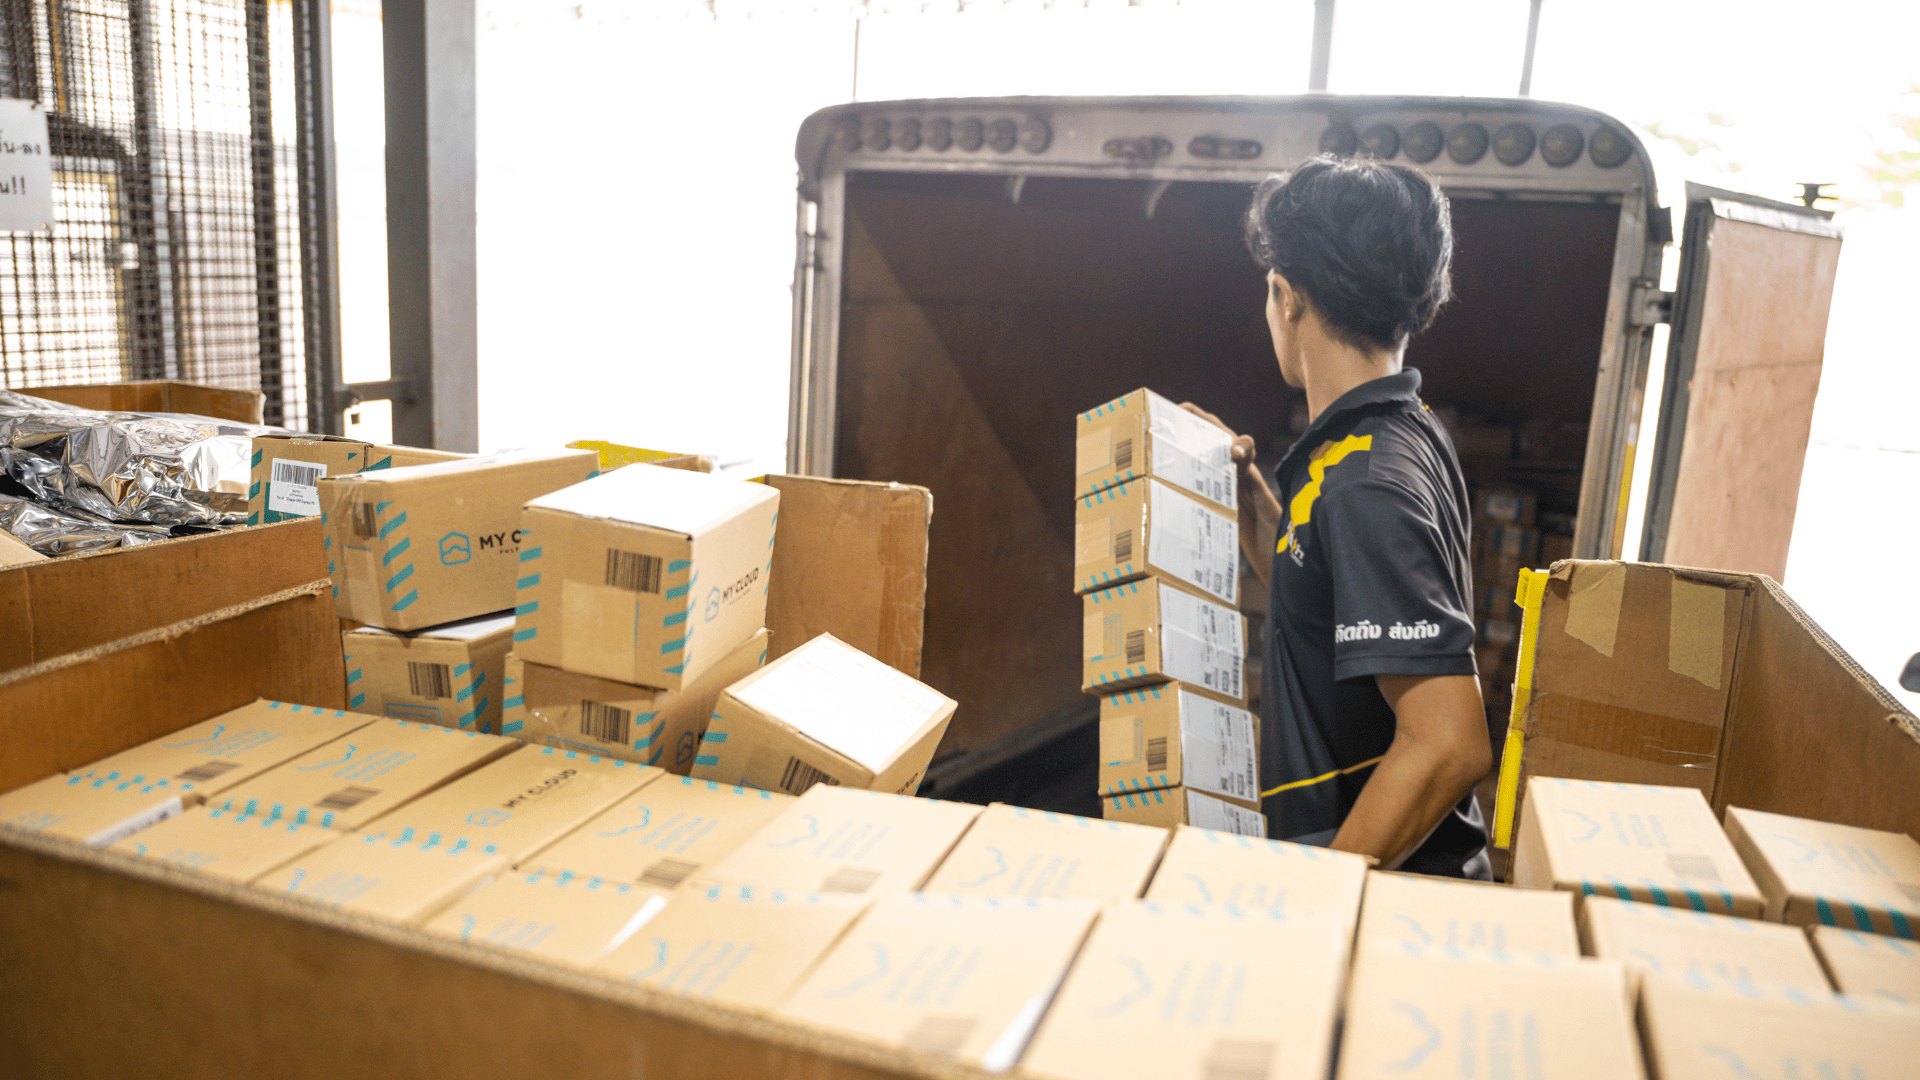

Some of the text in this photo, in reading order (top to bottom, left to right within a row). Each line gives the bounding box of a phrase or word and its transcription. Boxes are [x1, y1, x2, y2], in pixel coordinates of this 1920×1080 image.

[479, 531, 506, 550] MY
[722, 584, 735, 604] MY
[735, 567, 760, 593] CLOUD
[1335, 619, 1440, 644] คิดถึง ส่งถึง
[527, 768, 579, 796] CLOUD
